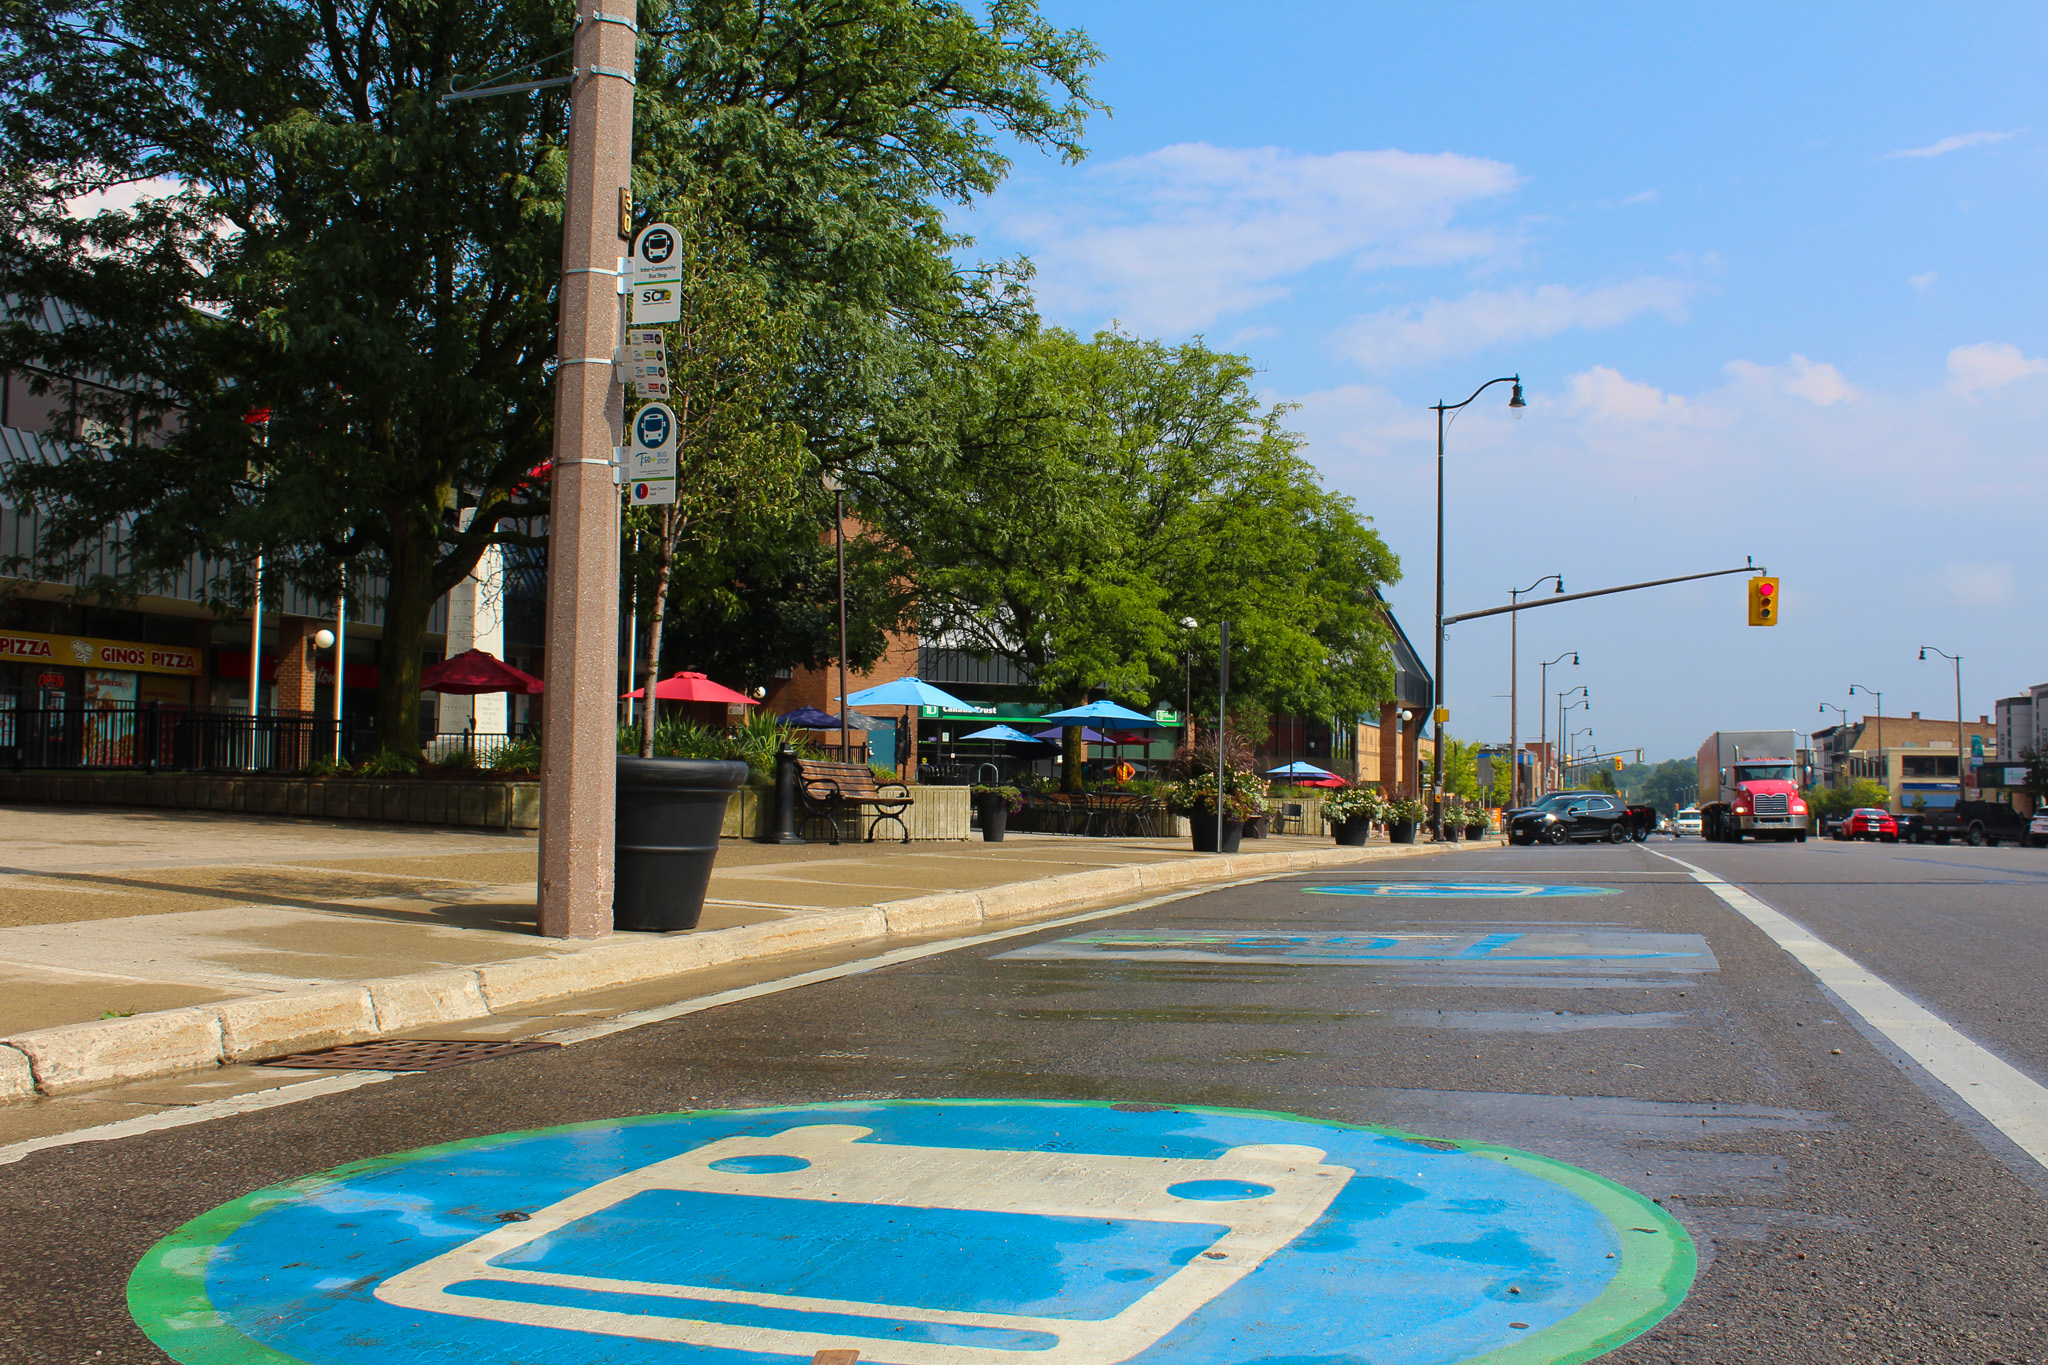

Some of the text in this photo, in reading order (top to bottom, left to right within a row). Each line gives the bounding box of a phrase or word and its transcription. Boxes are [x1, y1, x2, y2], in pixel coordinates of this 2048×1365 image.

[640, 265, 676, 273] Inter-Community
[656, 457, 670, 465] STOP
[0, 636, 53, 657] PIZZA
[101, 646, 196, 670] GINO'S PIZZA
[38, 673, 64, 688] OPEN
